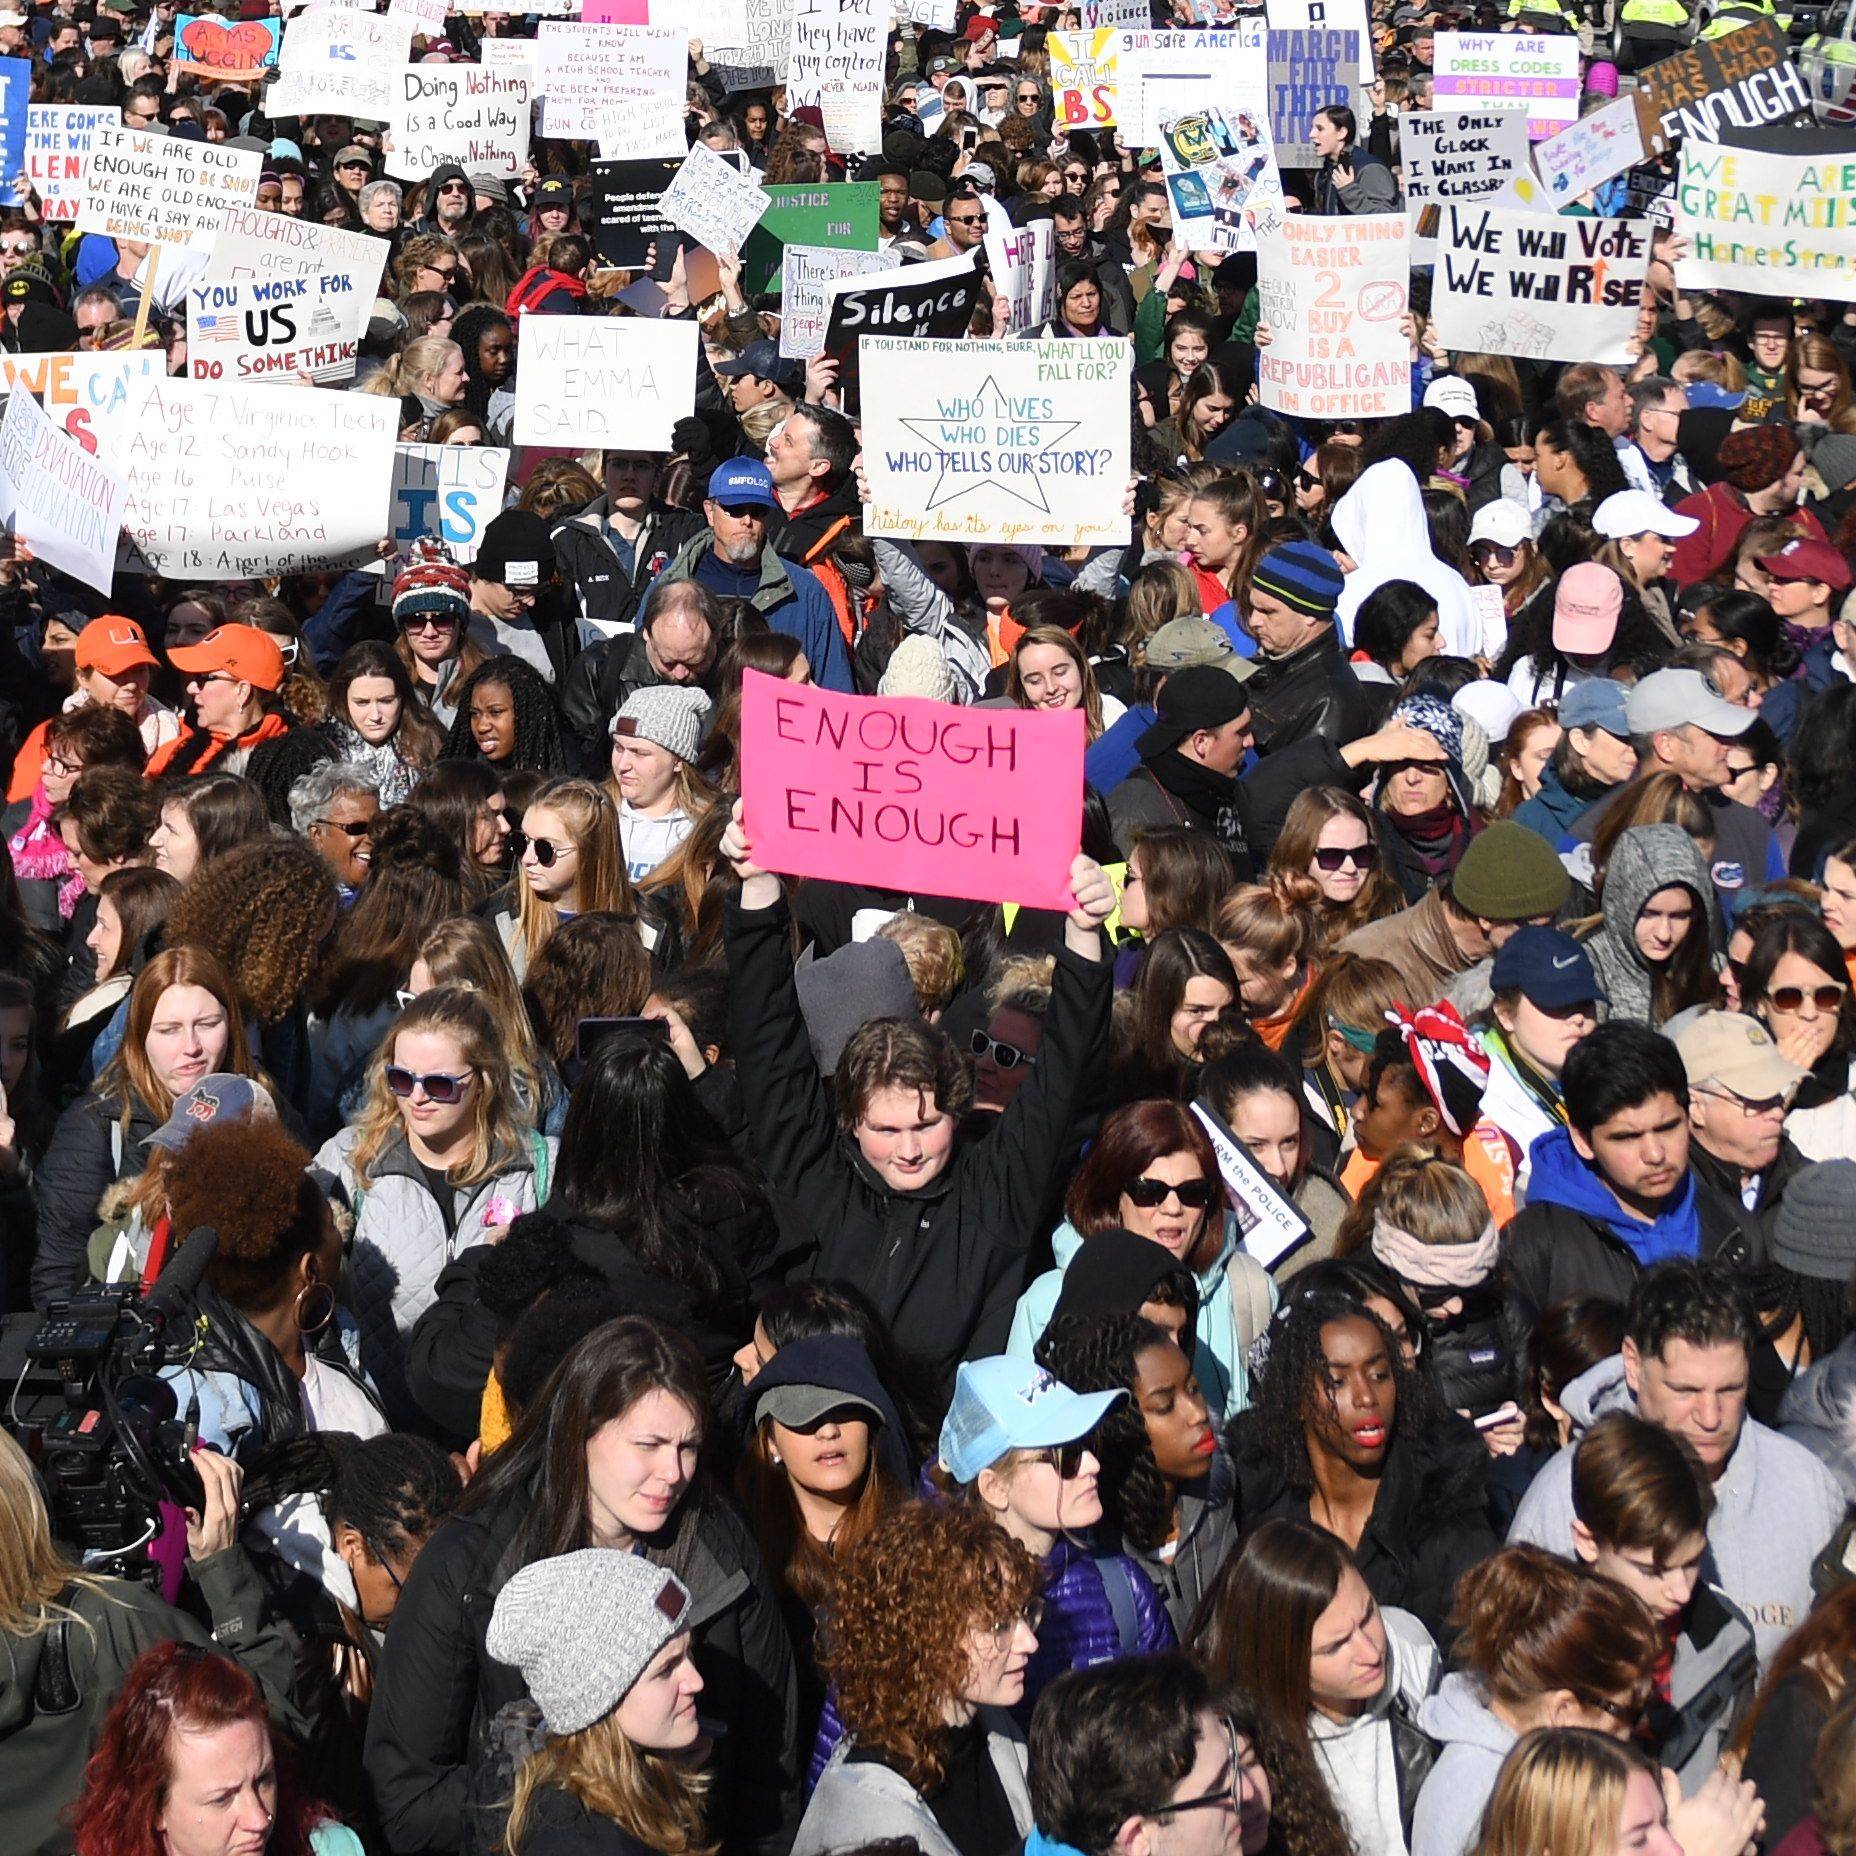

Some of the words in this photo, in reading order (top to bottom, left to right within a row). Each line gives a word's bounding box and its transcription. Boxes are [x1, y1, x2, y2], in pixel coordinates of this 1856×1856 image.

[797, 22, 831, 51] they
[837, 22, 876, 47] have
[1268, 29, 1360, 62] MARCH
[1459, 39, 1494, 52] WHY
[1515, 40, 1545, 54] ARE
[1290, 58, 1335, 85] FOR
[1450, 59, 1499, 72] DRESS
[1510, 61, 1562, 75] CODES
[1640, 51, 1702, 85] THIS
[1719, 46, 1778, 84] HAD
[405, 72, 457, 107] Doing
[466, 71, 528, 103] Nothing
[1063, 86, 1112, 124] BS
[1660, 61, 1812, 144] ENOUGH
[487, 112, 517, 136] Way
[1409, 119, 1444, 135] THE
[1458, 115, 1504, 130] ONLY
[100, 130, 125, 147] IF
[132, 135, 153, 155] WE
[163, 143, 192, 161] ARE
[203, 150, 238, 168] OLD
[469, 141, 518, 171] Nothing
[1435, 137, 1490, 154] GLOCK
[94, 154, 168, 181] ENOUGH
[175, 166, 195, 183] TO
[199, 171, 216, 186] BE
[222, 174, 257, 194] SHOT
[1432, 159, 1476, 176] WANT
[1487, 156, 1512, 171] IN
[1684, 148, 1736, 186] WE
[1797, 165, 1856, 193] ARE
[118, 182, 151, 200] ARE
[1681, 185, 1778, 225] GREAT
[1282, 221, 1336, 243] ONLY
[1342, 221, 1405, 242] THING
[791, 253, 835, 281] There's
[1291, 247, 1363, 267] EASIER
[192, 287, 238, 310] YOU
[253, 279, 307, 301] WORK
[320, 275, 353, 293] FOR
[1313, 271, 1346, 308] 2
[842, 289, 966, 326] Silence
[1308, 310, 1353, 334] BUY
[246, 303, 297, 347] US
[531, 326, 628, 361] WHAT
[874, 339, 893, 351] YOU
[896, 340, 929, 351] STAND
[932, 340, 953, 352] FOR
[1308, 337, 1331, 358] IS
[1336, 339, 1356, 359] A
[194, 359, 223, 380] DO
[237, 341, 358, 376] SOMETHING
[1038, 363, 1071, 381] FALL
[1077, 362, 1117, 380] FOR?
[1261, 354, 1409, 389] REPUBLICAN
[564, 364, 660, 400] EMMA
[937, 398, 984, 419] WHO
[994, 398, 1053, 419] LIVES
[1278, 389, 1300, 411] IN
[1311, 392, 1386, 413] OFFICE
[940, 424, 986, 444] WHO
[997, 426, 1040, 446] DIES
[885, 452, 931, 472] WHO
[935, 451, 992, 472] TELLS
[998, 453, 1034, 474] OUR
[1039, 448, 1112, 476] STORY?
[395, 489, 478, 544] IS
[776, 698, 1017, 772] ENOUGH
[852, 761, 922, 794] IS
[786, 787, 1020, 855] ENOUGH
[1252, 1186, 1292, 1230] POLICE
